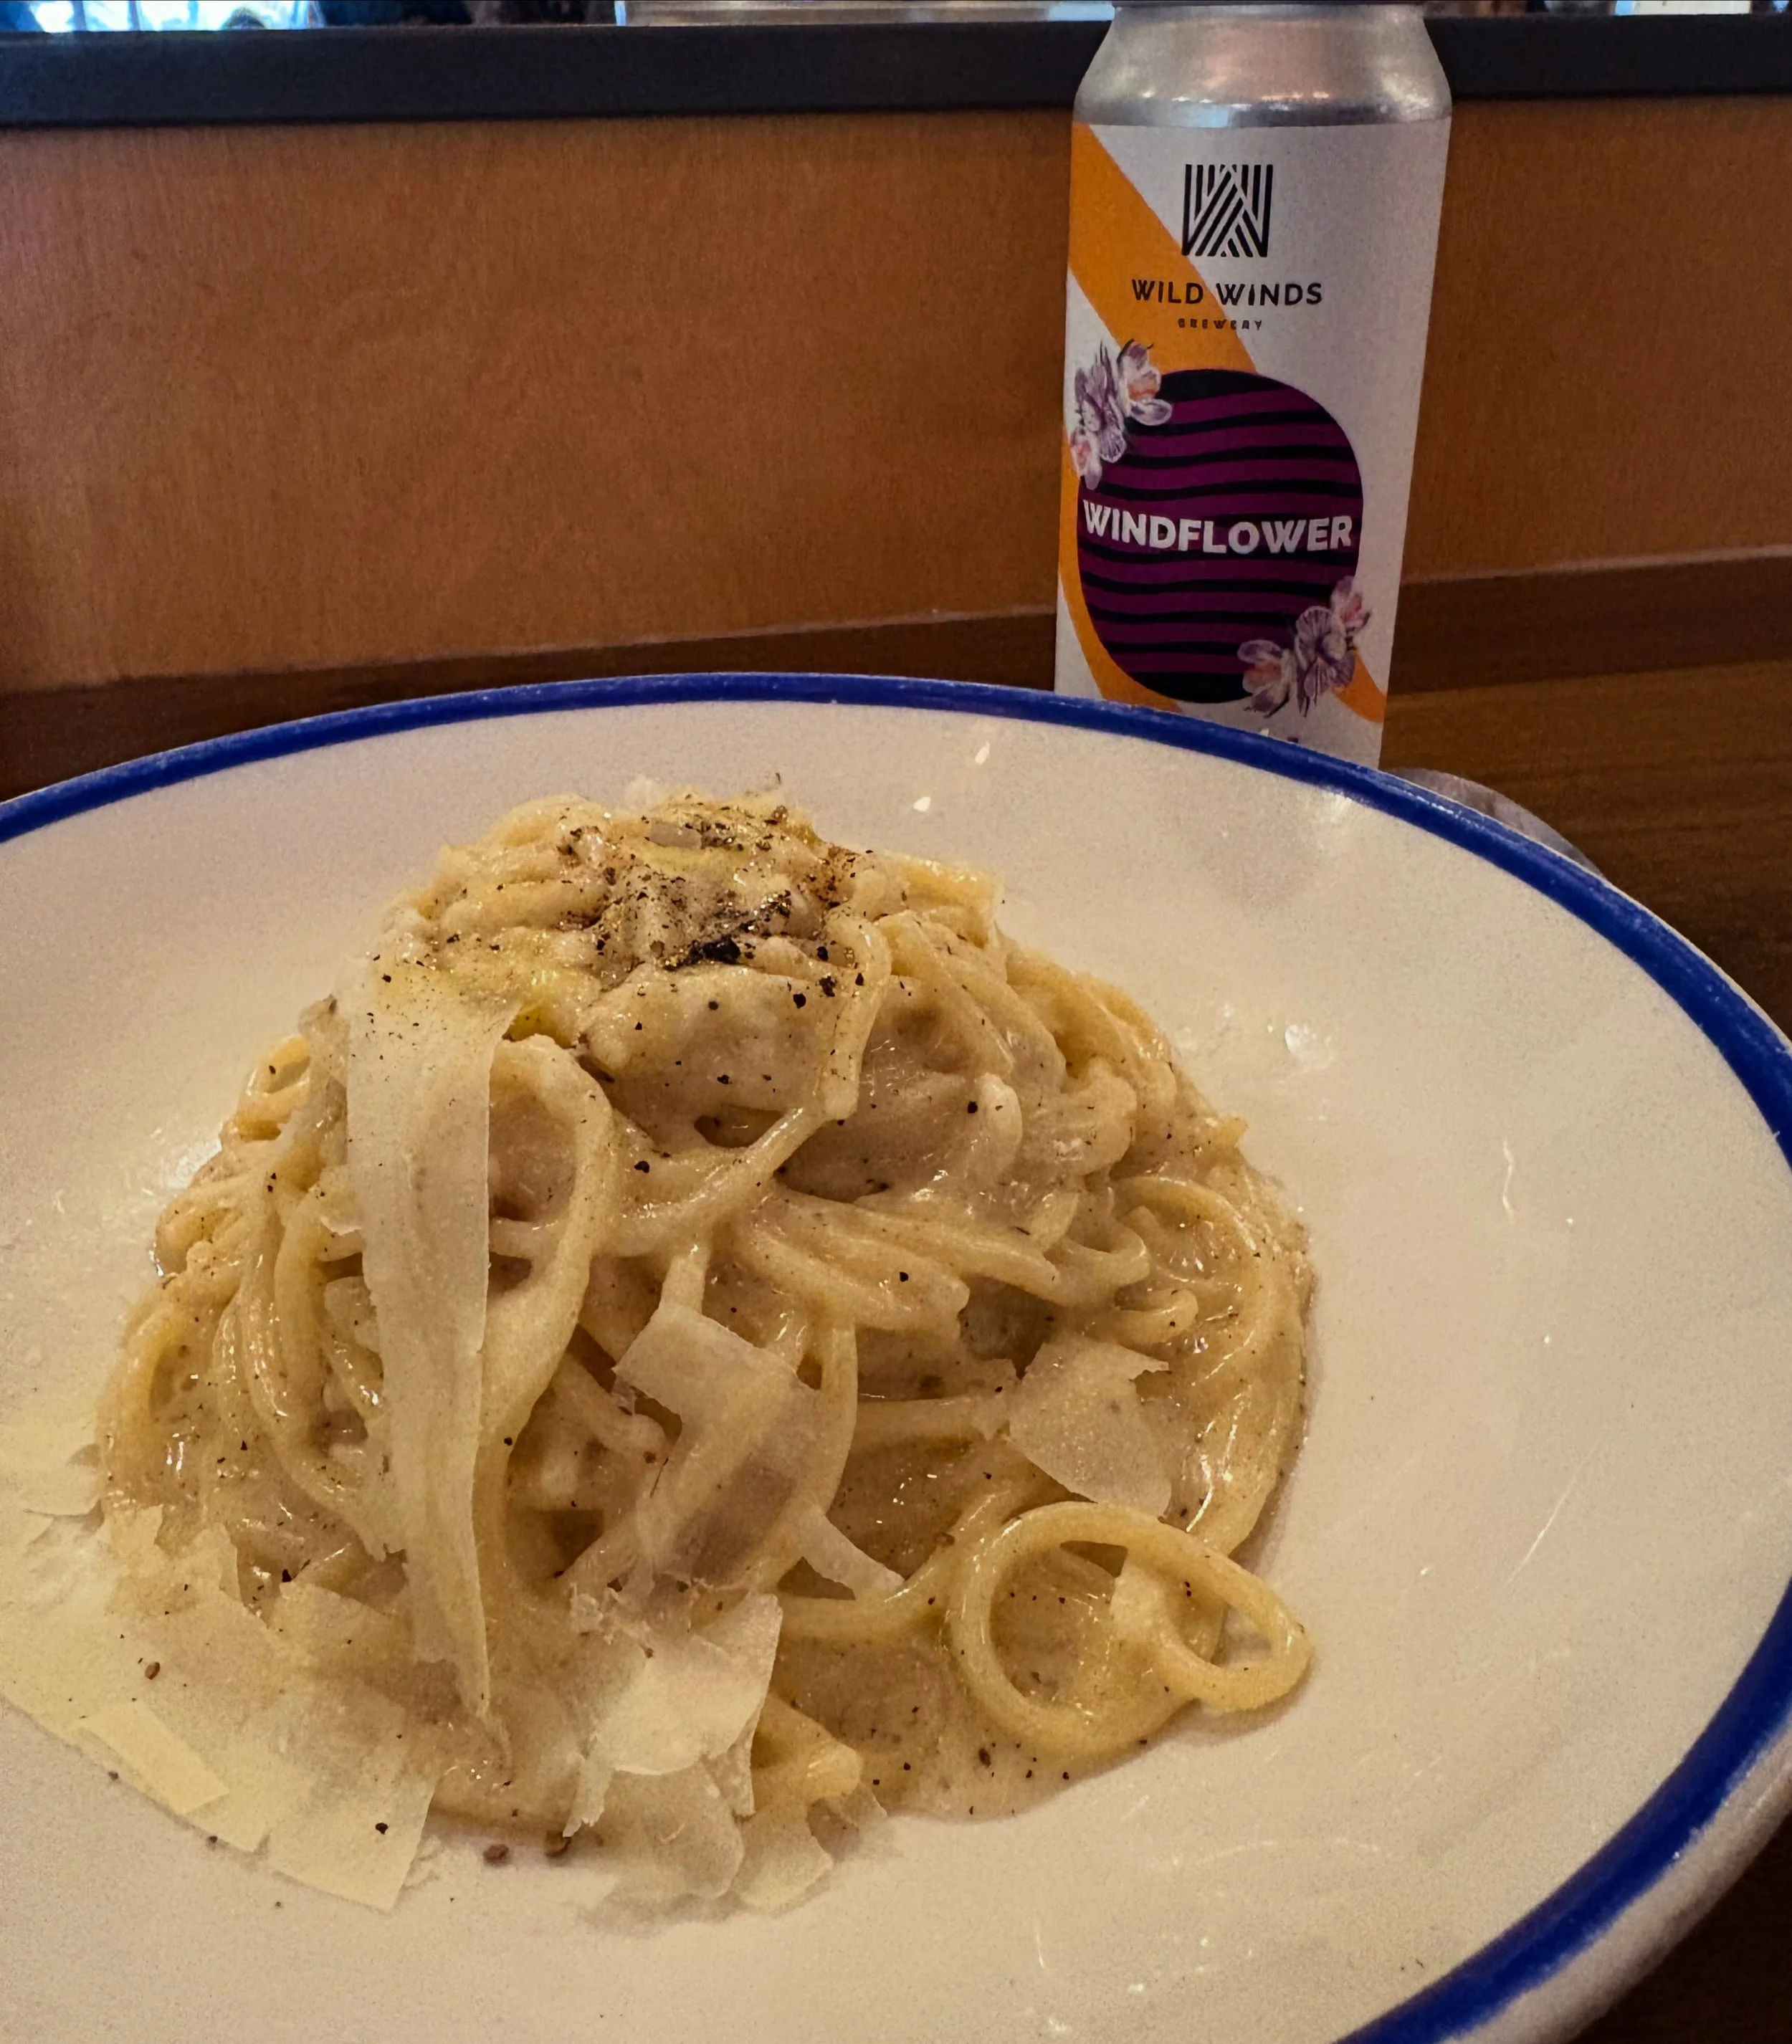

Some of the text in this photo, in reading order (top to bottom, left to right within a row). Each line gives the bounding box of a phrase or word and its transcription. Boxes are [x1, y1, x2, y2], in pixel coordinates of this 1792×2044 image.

[1132, 279, 1323, 307] WILD WINDS
[1178, 317, 1263, 330] BREWERY
[1082, 500, 1353, 554] WINDFLOWER
